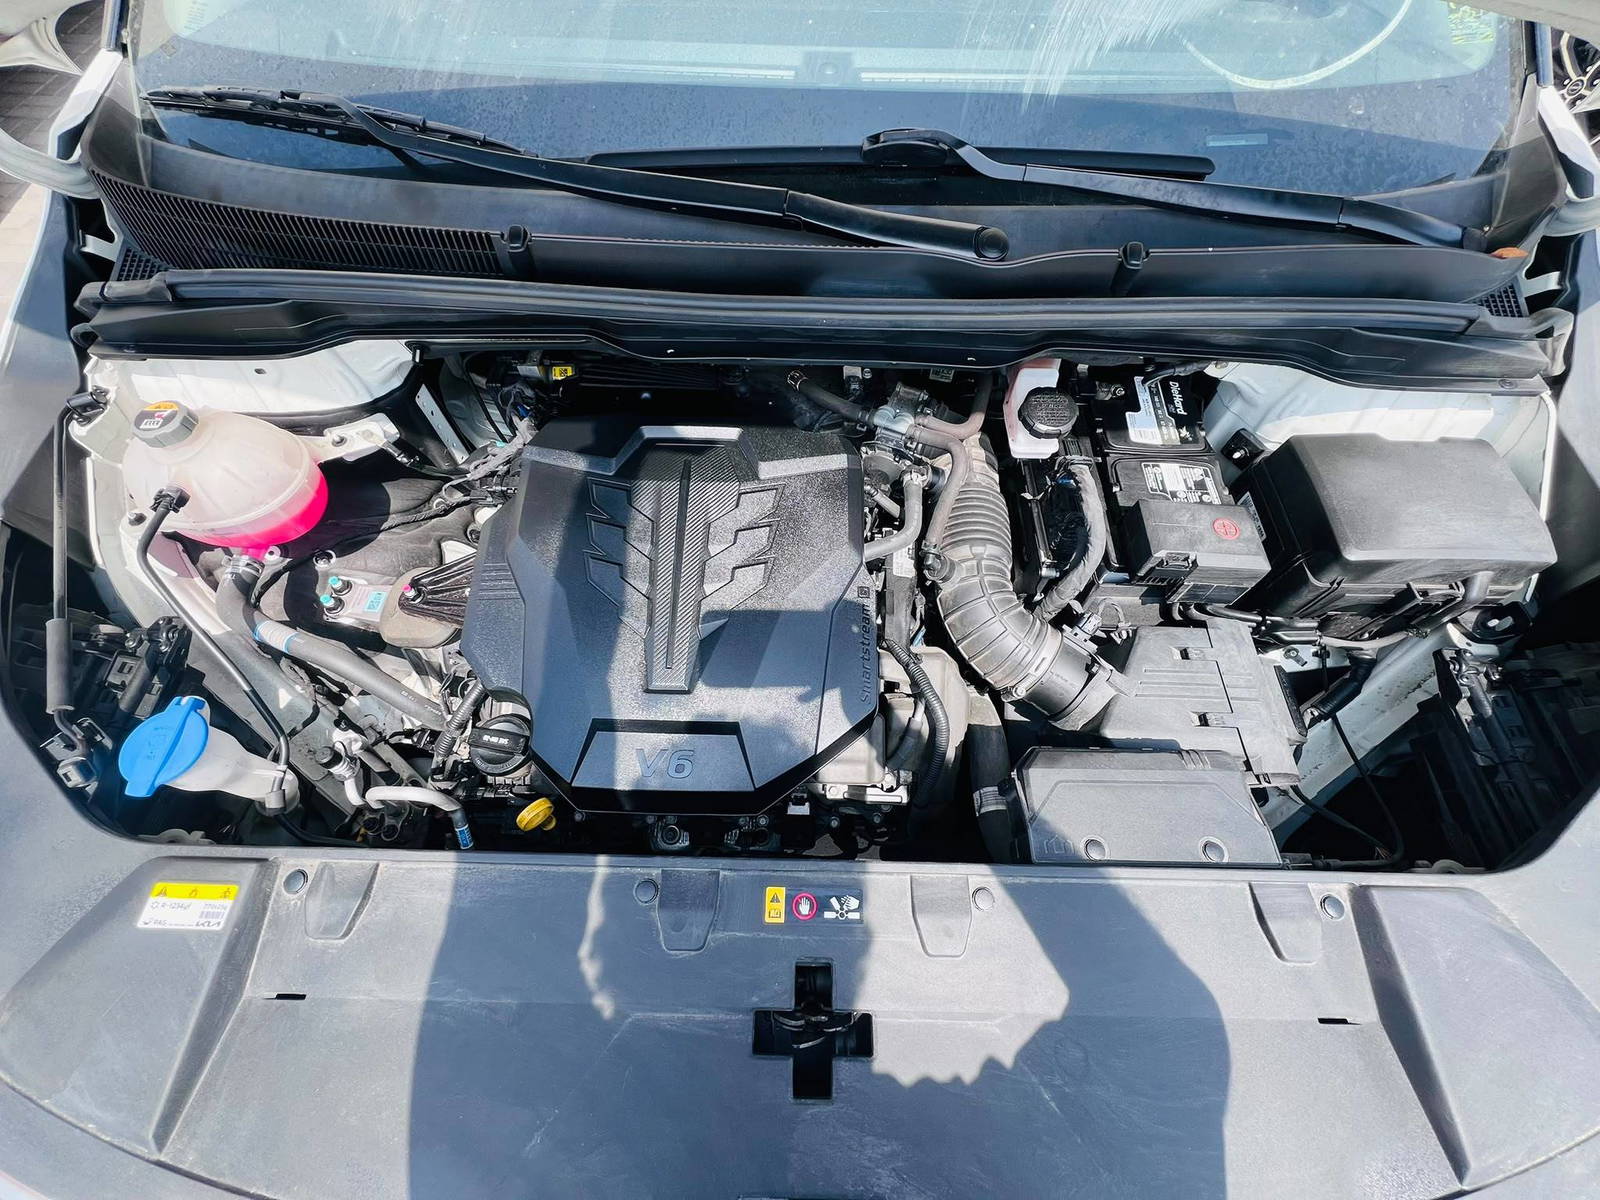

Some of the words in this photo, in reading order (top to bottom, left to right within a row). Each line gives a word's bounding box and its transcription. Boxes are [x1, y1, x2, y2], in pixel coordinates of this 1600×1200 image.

[1169, 381, 1188, 415] DieHard
[860, 603, 871, 705] Smartstream
[636, 749, 694, 779] V6
